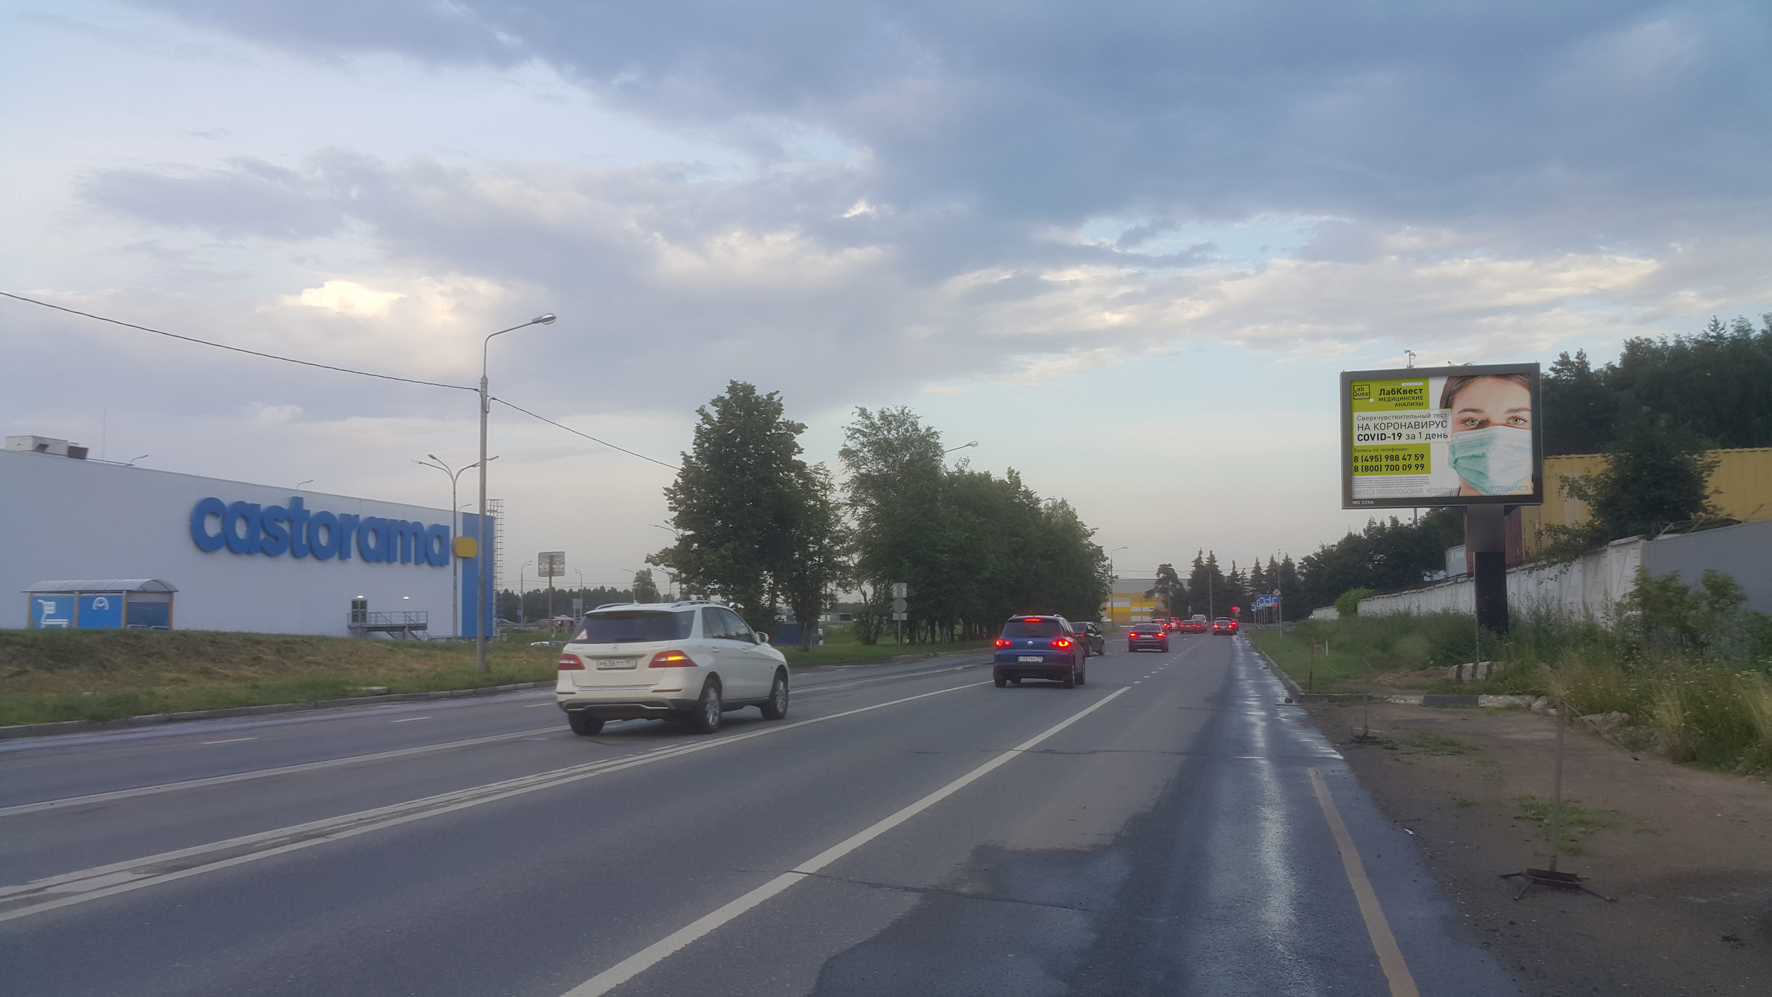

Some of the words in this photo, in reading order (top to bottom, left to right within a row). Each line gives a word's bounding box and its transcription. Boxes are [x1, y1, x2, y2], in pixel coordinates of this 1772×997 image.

[1378, 388, 1424, 396] ЛабКвест
[1356, 412, 1432, 422] Сверхчувствительный
[1357, 423, 1371, 432] НА
[1373, 420, 1448, 430] КОРОНАВИРУС
[1356, 432, 1402, 442] COVID-19
[1418, 432, 1422, 440] 1
[1361, 454, 1382, 463] (495)
[1361, 464, 1382, 472] (800)
[190, 496, 450, 567] castorama
